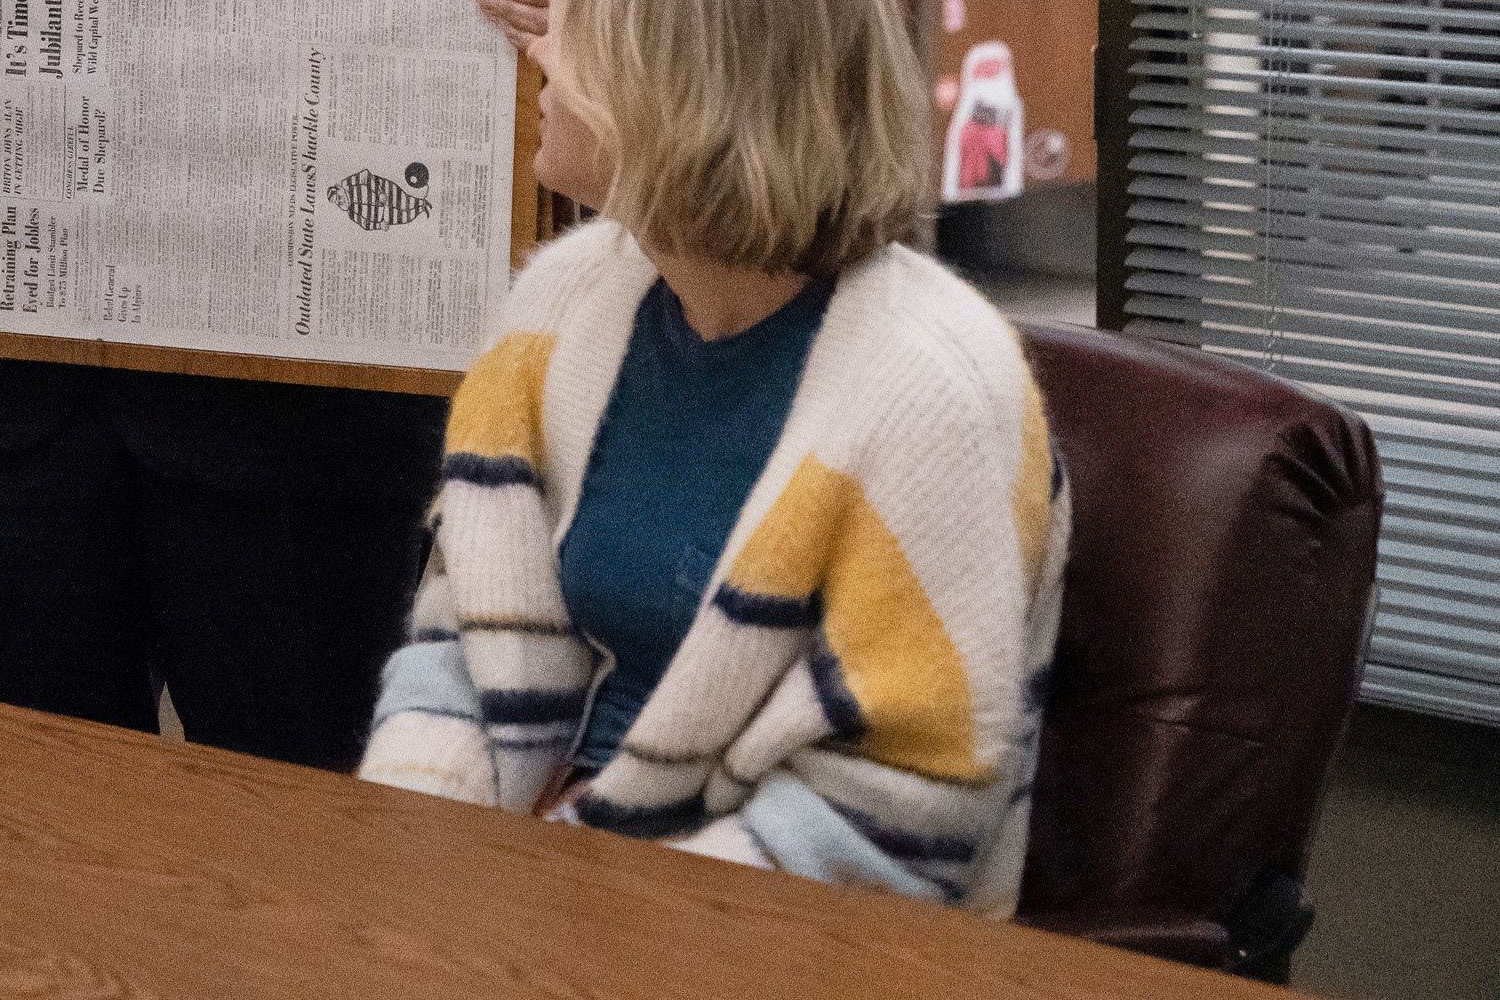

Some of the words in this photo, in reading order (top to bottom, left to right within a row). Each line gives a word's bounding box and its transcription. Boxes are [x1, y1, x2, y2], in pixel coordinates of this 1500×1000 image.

[39, 0, 63, 79] Jubilant
[74, 24, 84, 32] to
[88, 17, 101, 50] Capital
[5, 46, 28, 77] It’s
[72, 34, 85, 74] Shepard
[87, 52, 97, 74] Wild
[304, 48, 326, 106] County
[4, 100, 12, 121] ALAN
[78, 96, 90, 135] Honor
[4, 128, 12, 154] JOINS
[78, 138, 90, 152] of
[94, 109, 110, 164] Shepard?
[14, 140, 23, 180] GETTING
[76, 156, 89, 192] Medal
[290, 144, 298, 192] LEGISLATIVE
[3, 158, 11, 194] BRITON
[14, 184, 21, 195] IN
[93, 170, 104, 193] Due
[2, 206, 16, 235] Plan
[24, 208, 40, 253] Jobless
[60, 228, 68, 247] Plan
[298, 219, 315, 260] State
[0, 240, 21, 311] Retraining
[24, 258, 38, 278] for
[48, 255, 56, 276] Limit
[60, 250, 68, 278] Million
[46, 280, 56, 308] Budget
[104, 265, 114, 297] General
[22, 282, 42, 313] Eyed
[58, 298, 66, 308] To
[294, 260, 312, 336] Outdated
